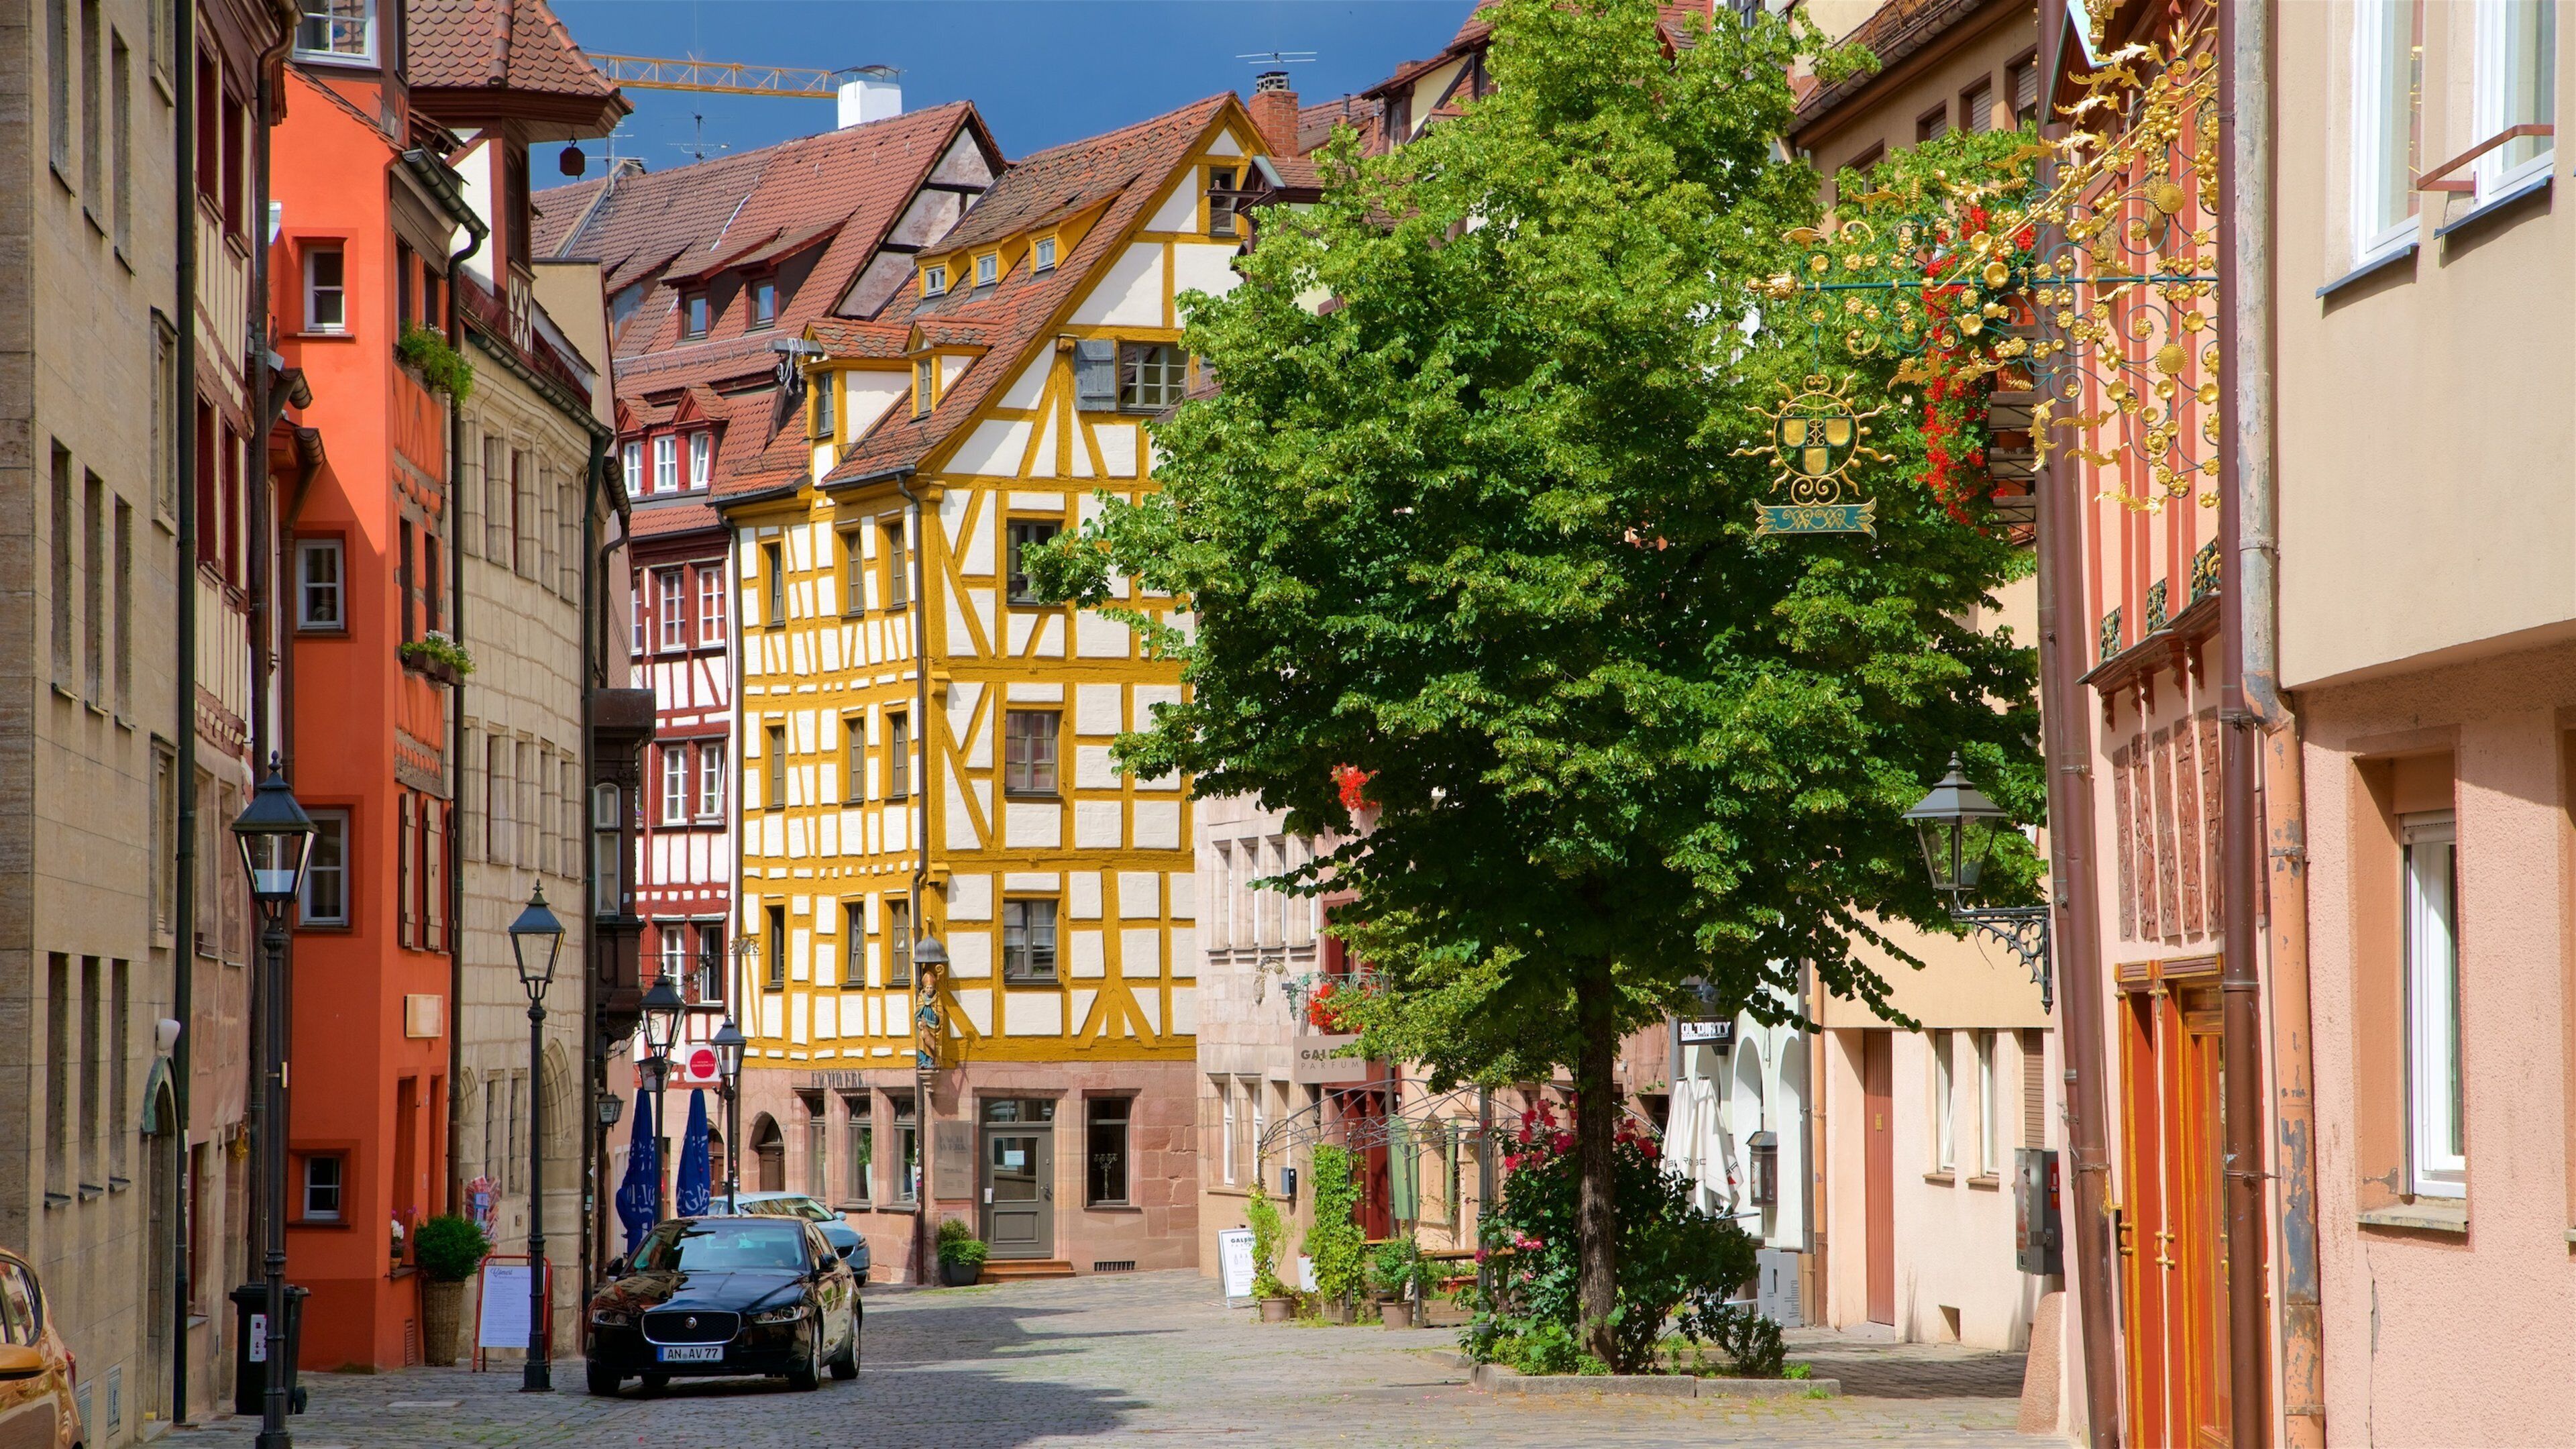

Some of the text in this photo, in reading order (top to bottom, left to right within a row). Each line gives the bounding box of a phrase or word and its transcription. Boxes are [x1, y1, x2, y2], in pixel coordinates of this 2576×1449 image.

[1301, 1049, 1358, 1060] GALE
[1301, 1061, 1359, 1070] PARFUM
[1784, 1279, 1800, 1319] Marlboro
[667, 1348, 718, 1359] AN AV 77
